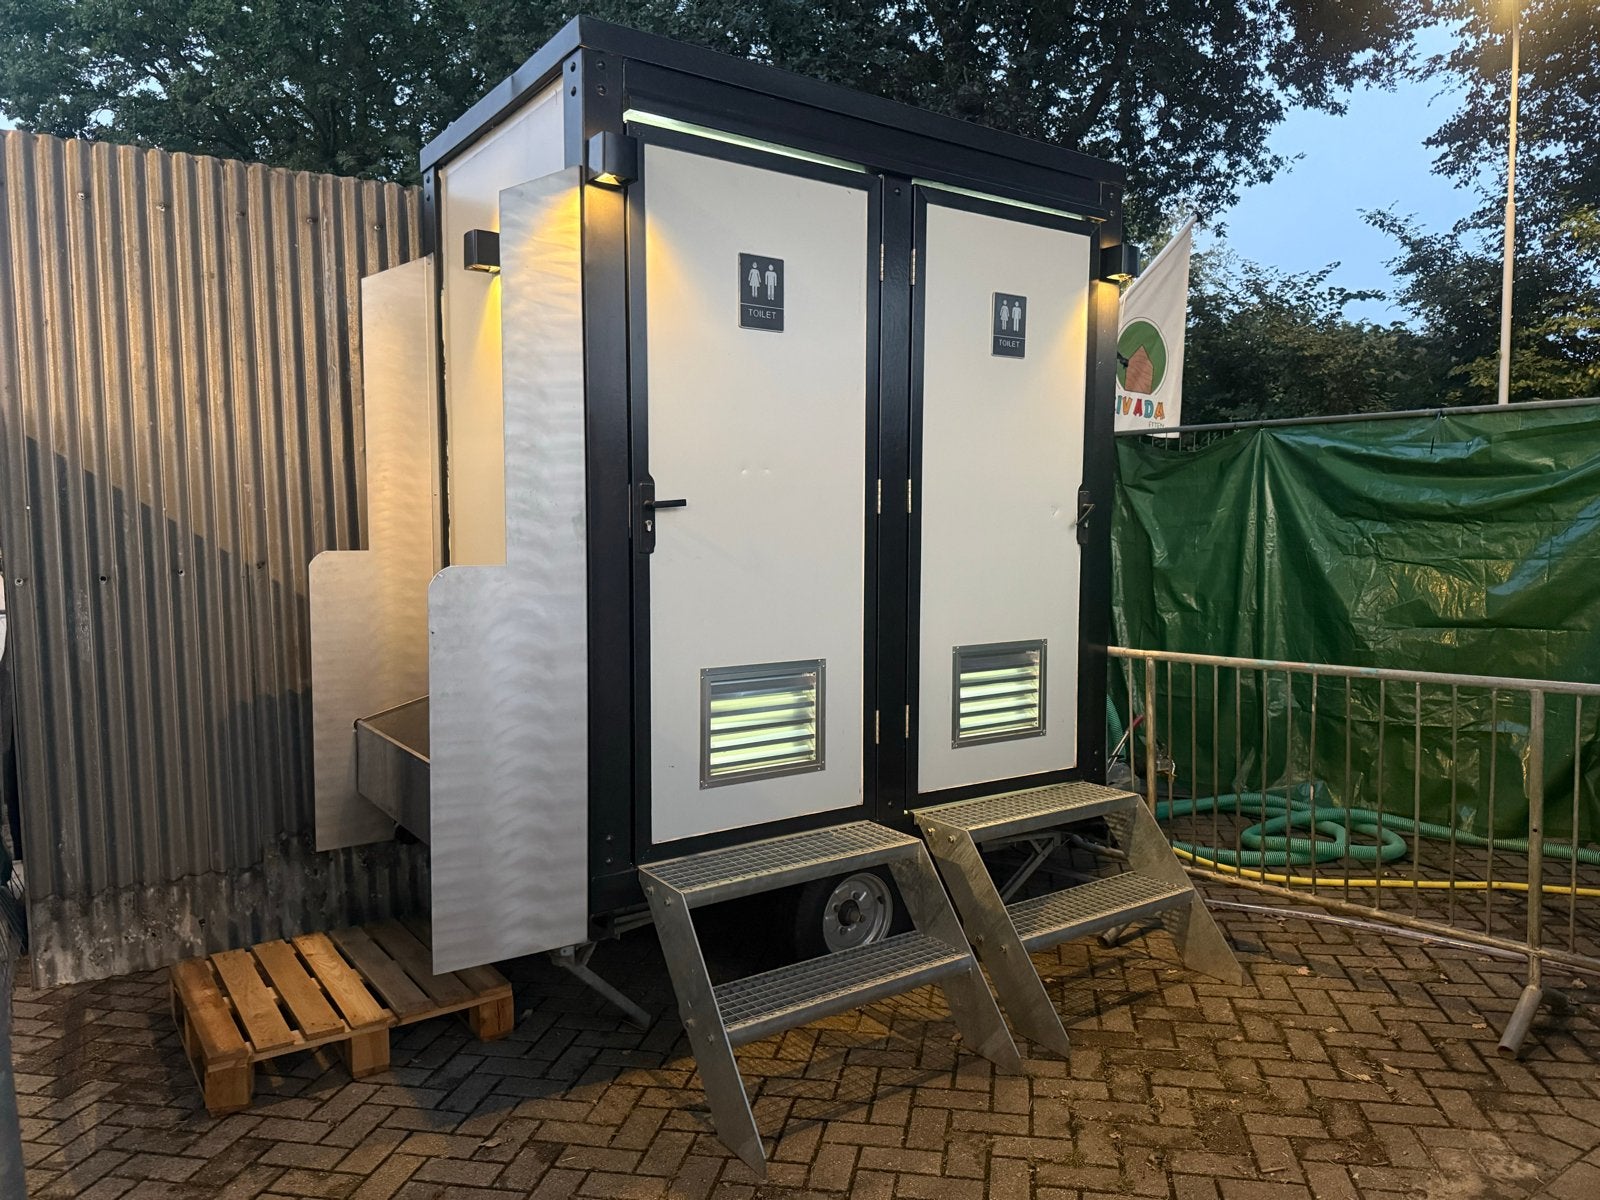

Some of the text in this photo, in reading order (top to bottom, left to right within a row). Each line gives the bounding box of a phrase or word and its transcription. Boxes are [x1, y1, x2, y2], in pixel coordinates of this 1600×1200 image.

[748, 308, 777, 320] TOILET
[998, 339, 1020, 348] TOILET
[1116, 395, 1165, 420] IVADA
